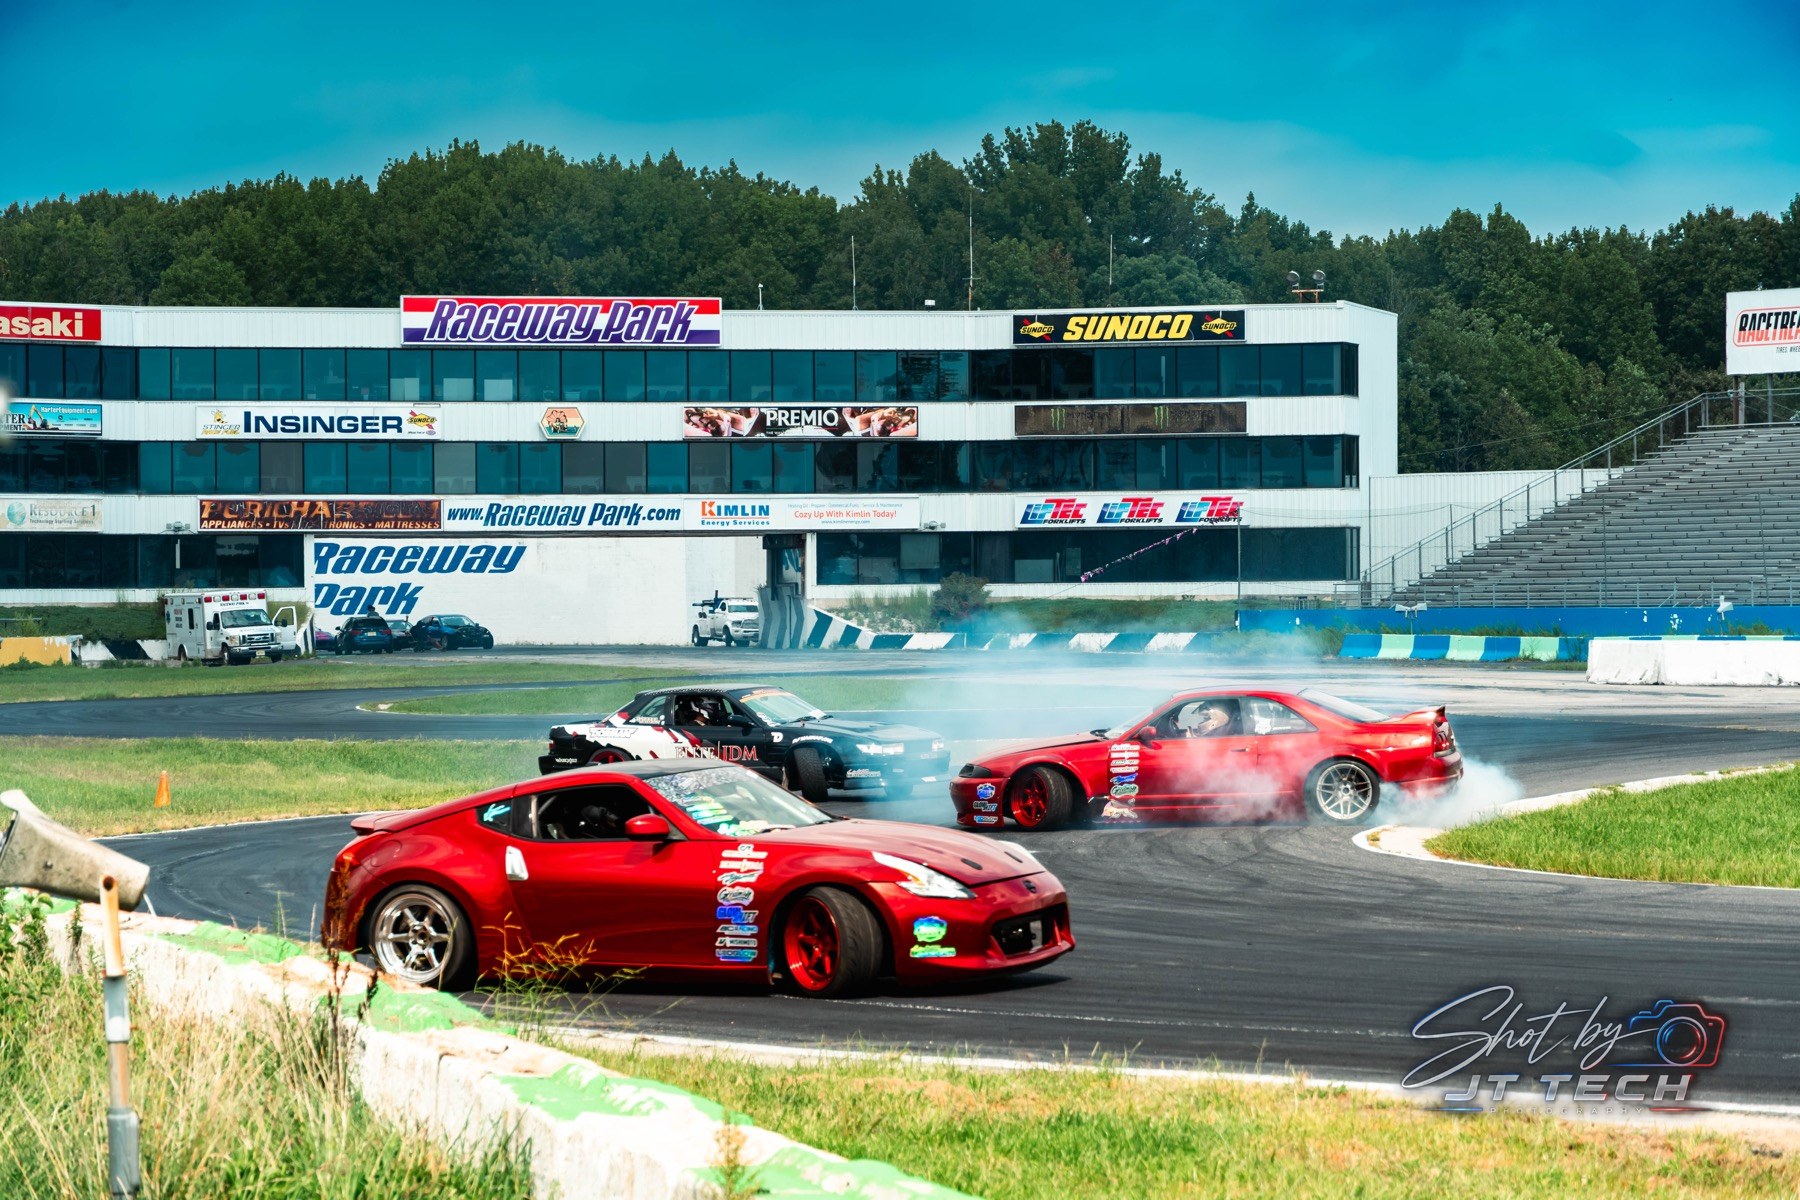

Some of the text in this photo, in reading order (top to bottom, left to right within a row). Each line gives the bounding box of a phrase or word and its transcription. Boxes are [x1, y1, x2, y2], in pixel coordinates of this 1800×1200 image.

[0, 311, 83, 337] asaki
[423, 299, 699, 342] Raceway Park
[1063, 314, 1194, 341] SUNOCO
[1202, 322, 1237, 330] SUNOCO
[1020, 326, 1054, 334] SUNOCO
[0, 413, 26, 424] TER
[244, 411, 403, 433] INSINGER
[766, 410, 839, 426] PREMIO
[447, 503, 586, 527] www.Raceway
[588, 502, 681, 526] Park.com
[701, 501, 770, 516] KIMLIN
[794, 511, 811, 519] Cozy
[814, 510, 824, 519] Up
[826, 510, 843, 518] With
[872, 510, 897, 519] Today!
[201, 521, 263, 529] APPLIANCES
[273, 521, 289, 529] TVs
[375, 521, 440, 529] MATTRESSES
[314, 542, 528, 574] Raceway
[314, 583, 424, 616] Park
[722, 745, 758, 761] JDM
